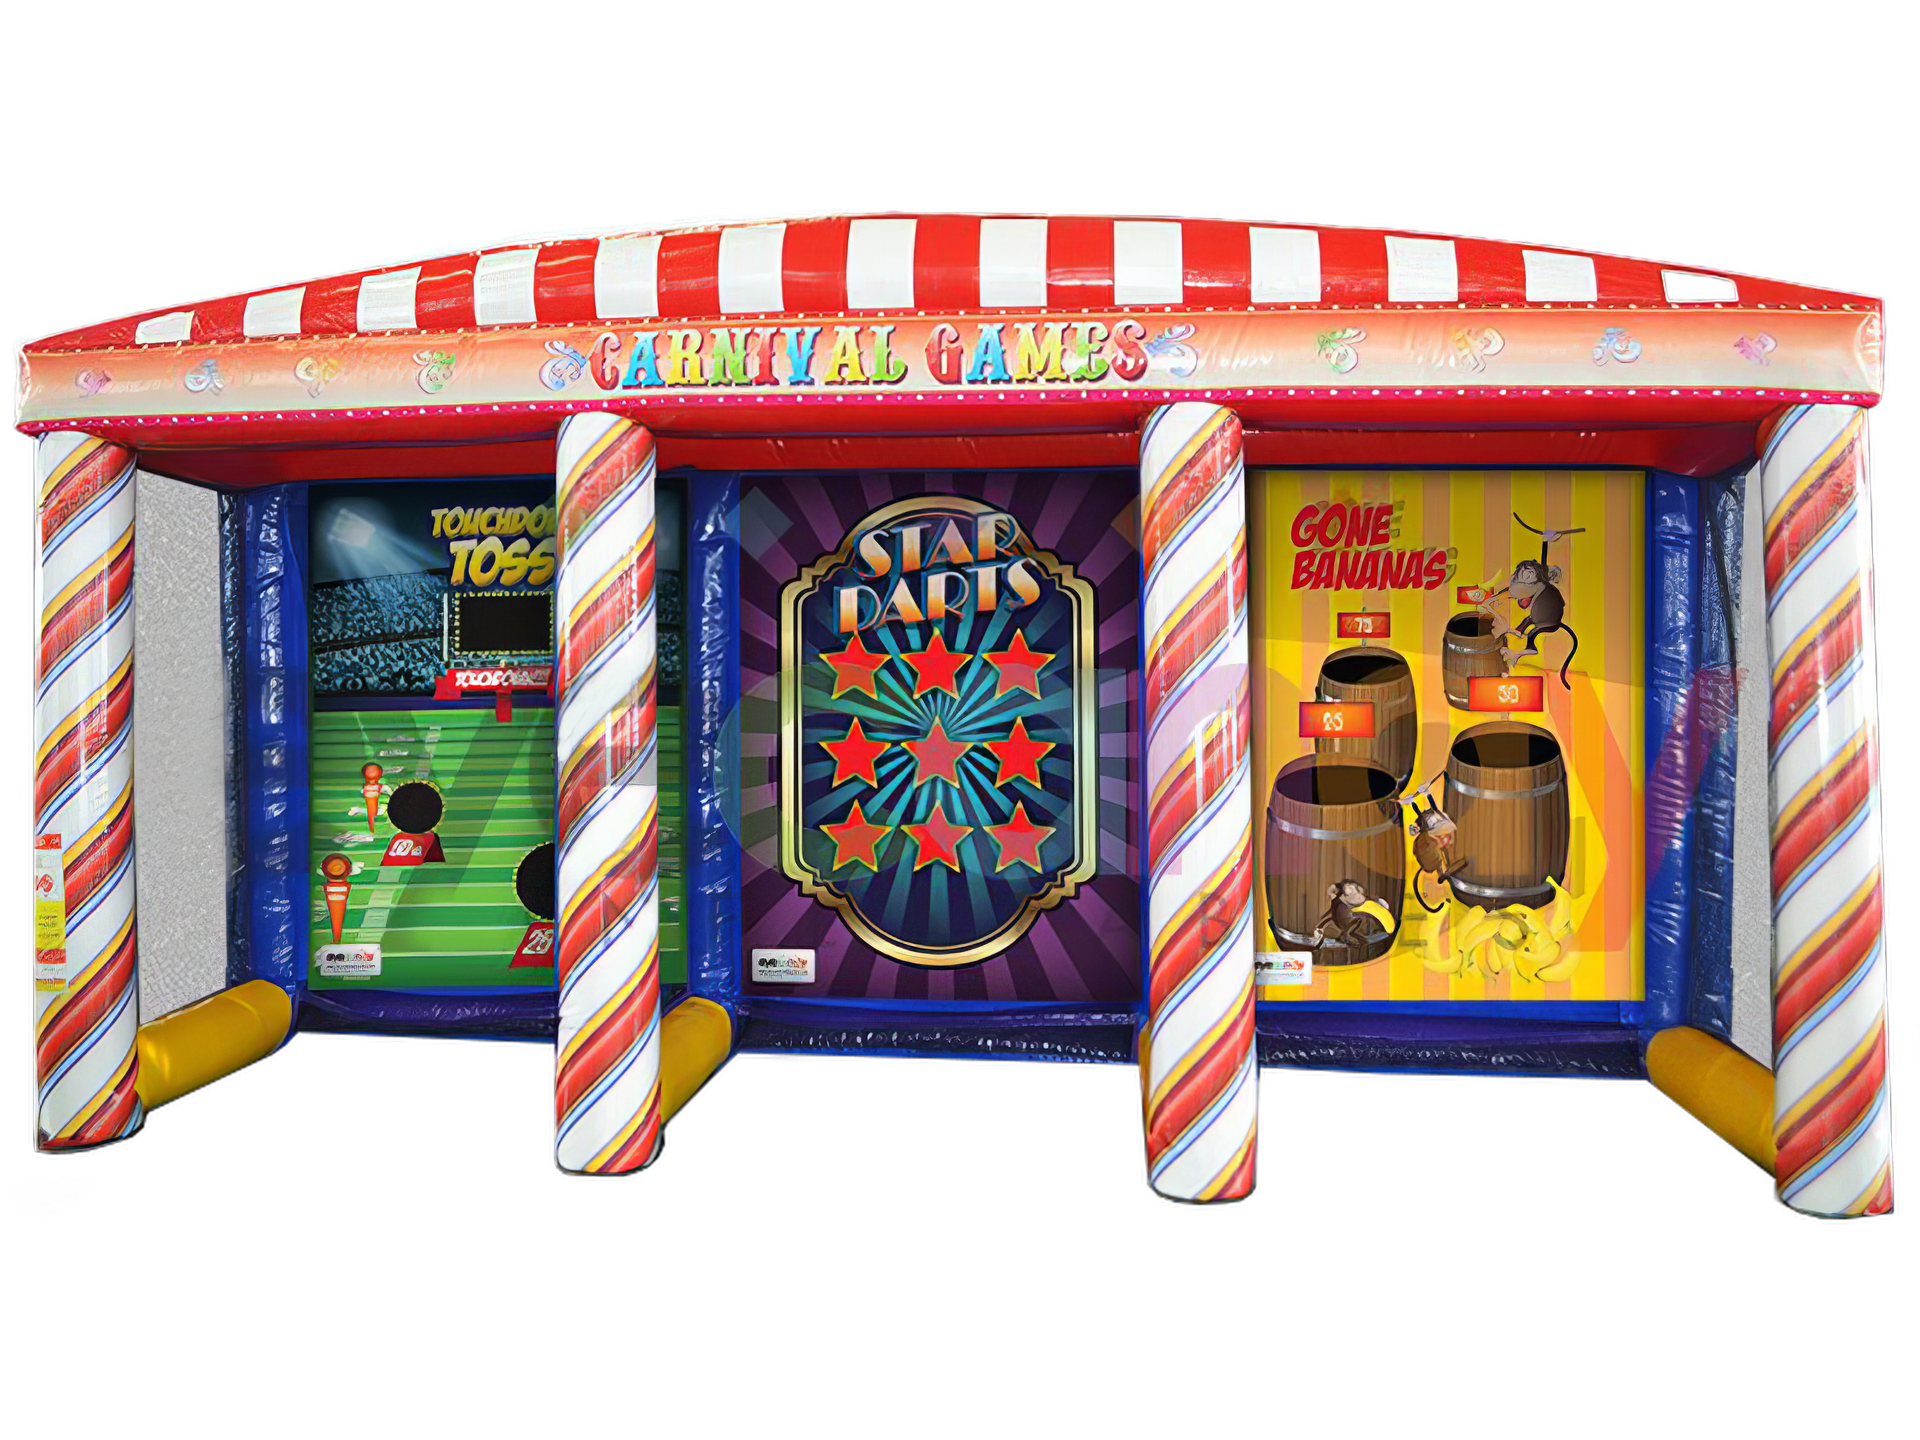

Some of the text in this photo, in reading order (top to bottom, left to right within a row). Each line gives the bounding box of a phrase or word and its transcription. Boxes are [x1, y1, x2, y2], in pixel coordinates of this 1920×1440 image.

[588, 319, 1148, 390] CARNIVAL GAMES
[853, 513, 1020, 580] STAR
[1291, 503, 1395, 547] GONE
[450, 535, 555, 586] TOSS
[1291, 549, 1448, 591] BANANAS
